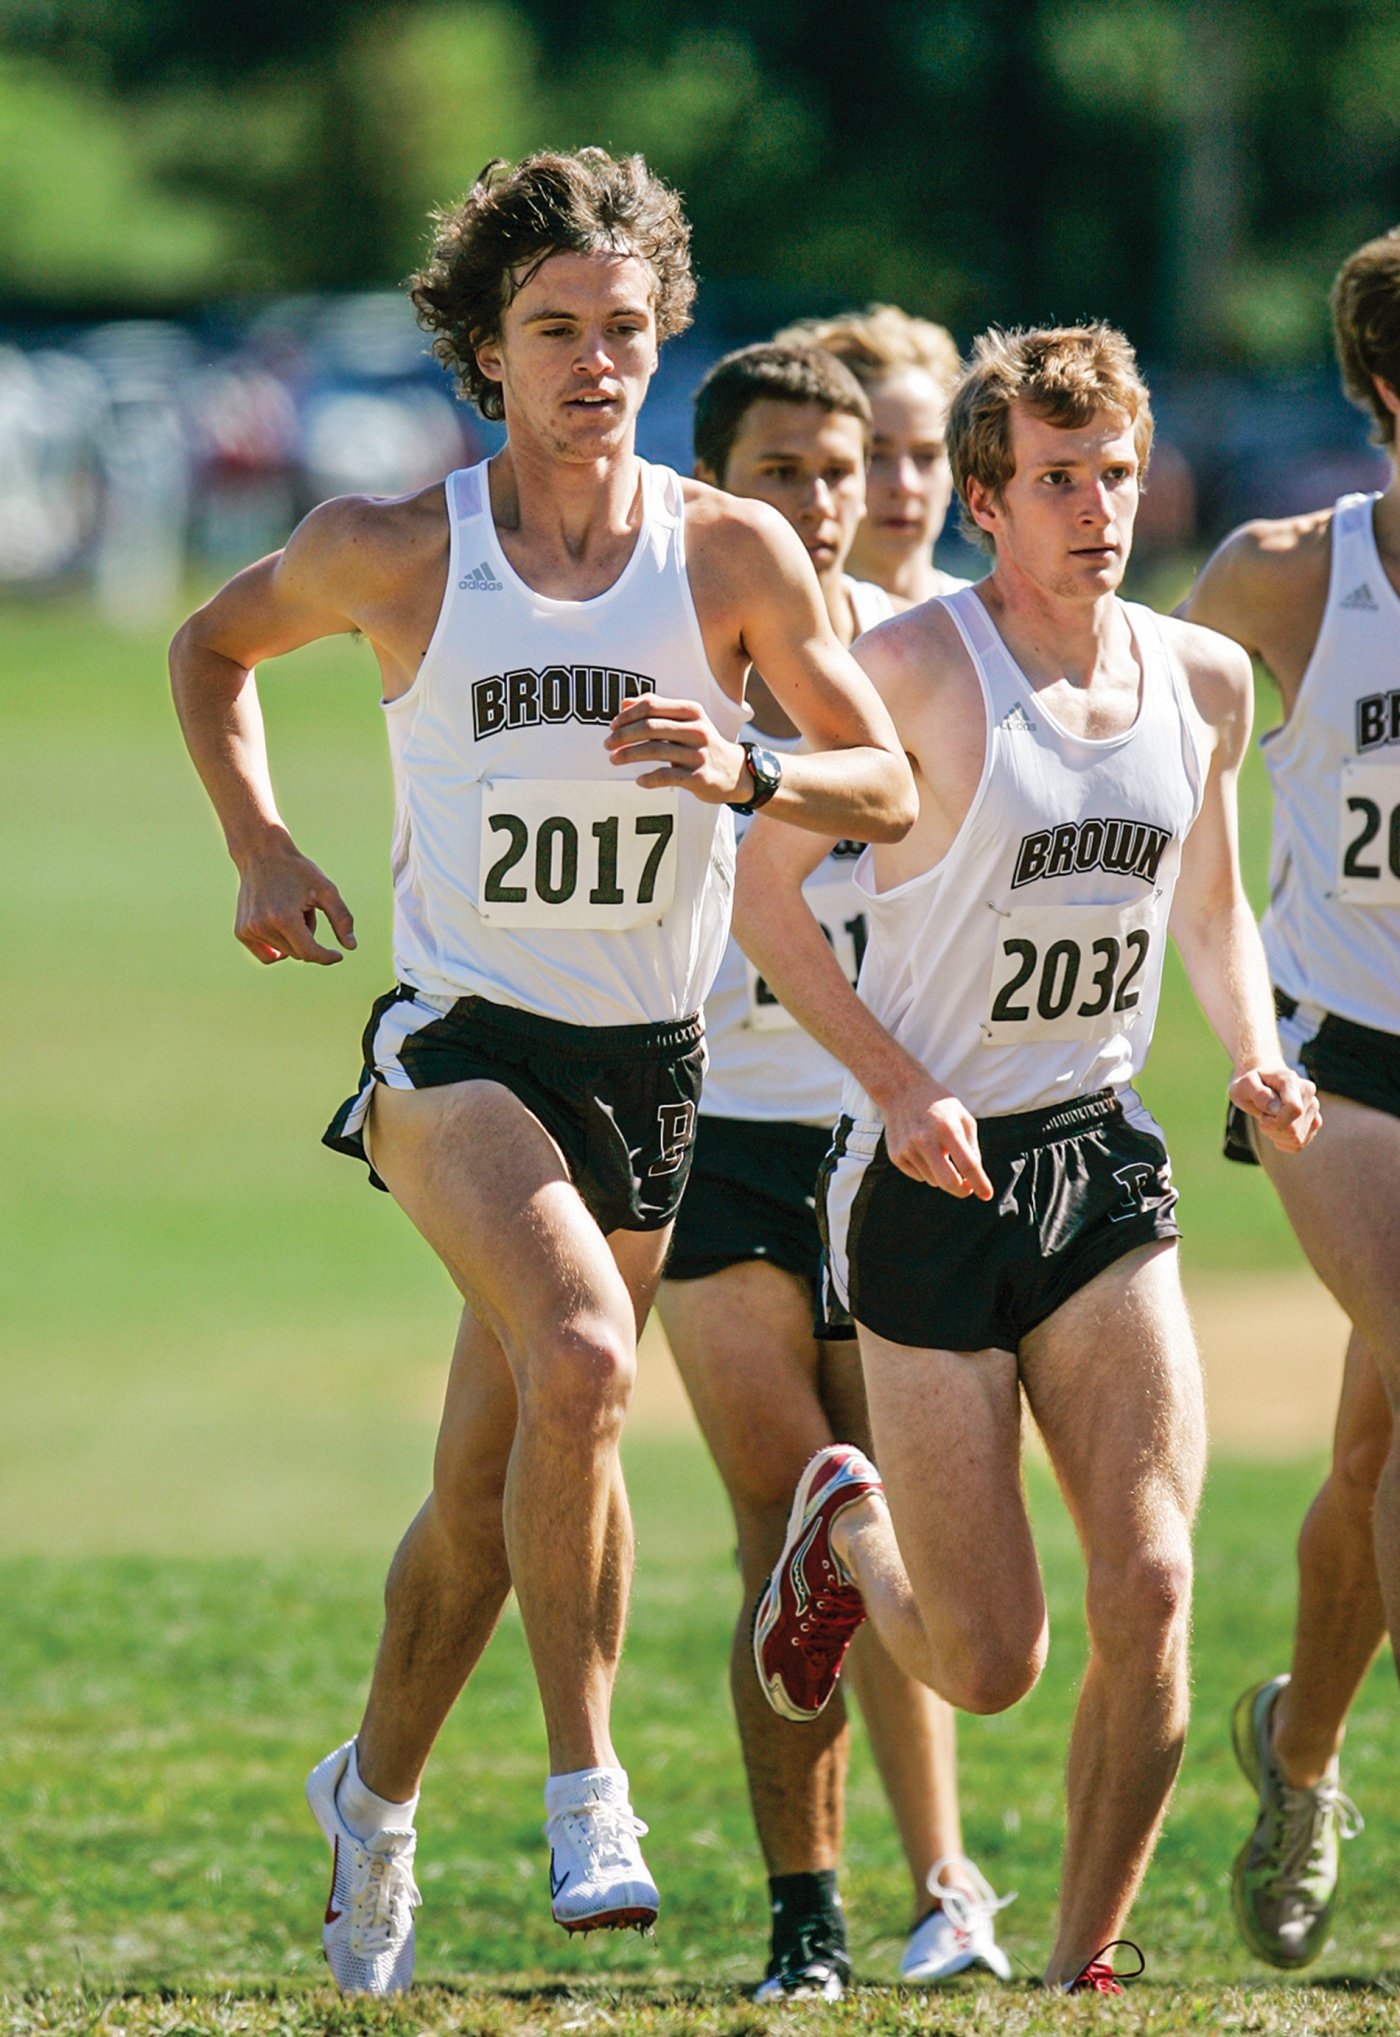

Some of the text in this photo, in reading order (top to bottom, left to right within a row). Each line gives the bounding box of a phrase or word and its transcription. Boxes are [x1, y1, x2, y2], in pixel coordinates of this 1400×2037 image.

[459, 579, 503, 591] adidas
[484, 813, 674, 905] 2017
[1010, 818, 1173, 890] BROWN
[991, 928, 1150, 1022] 2032
